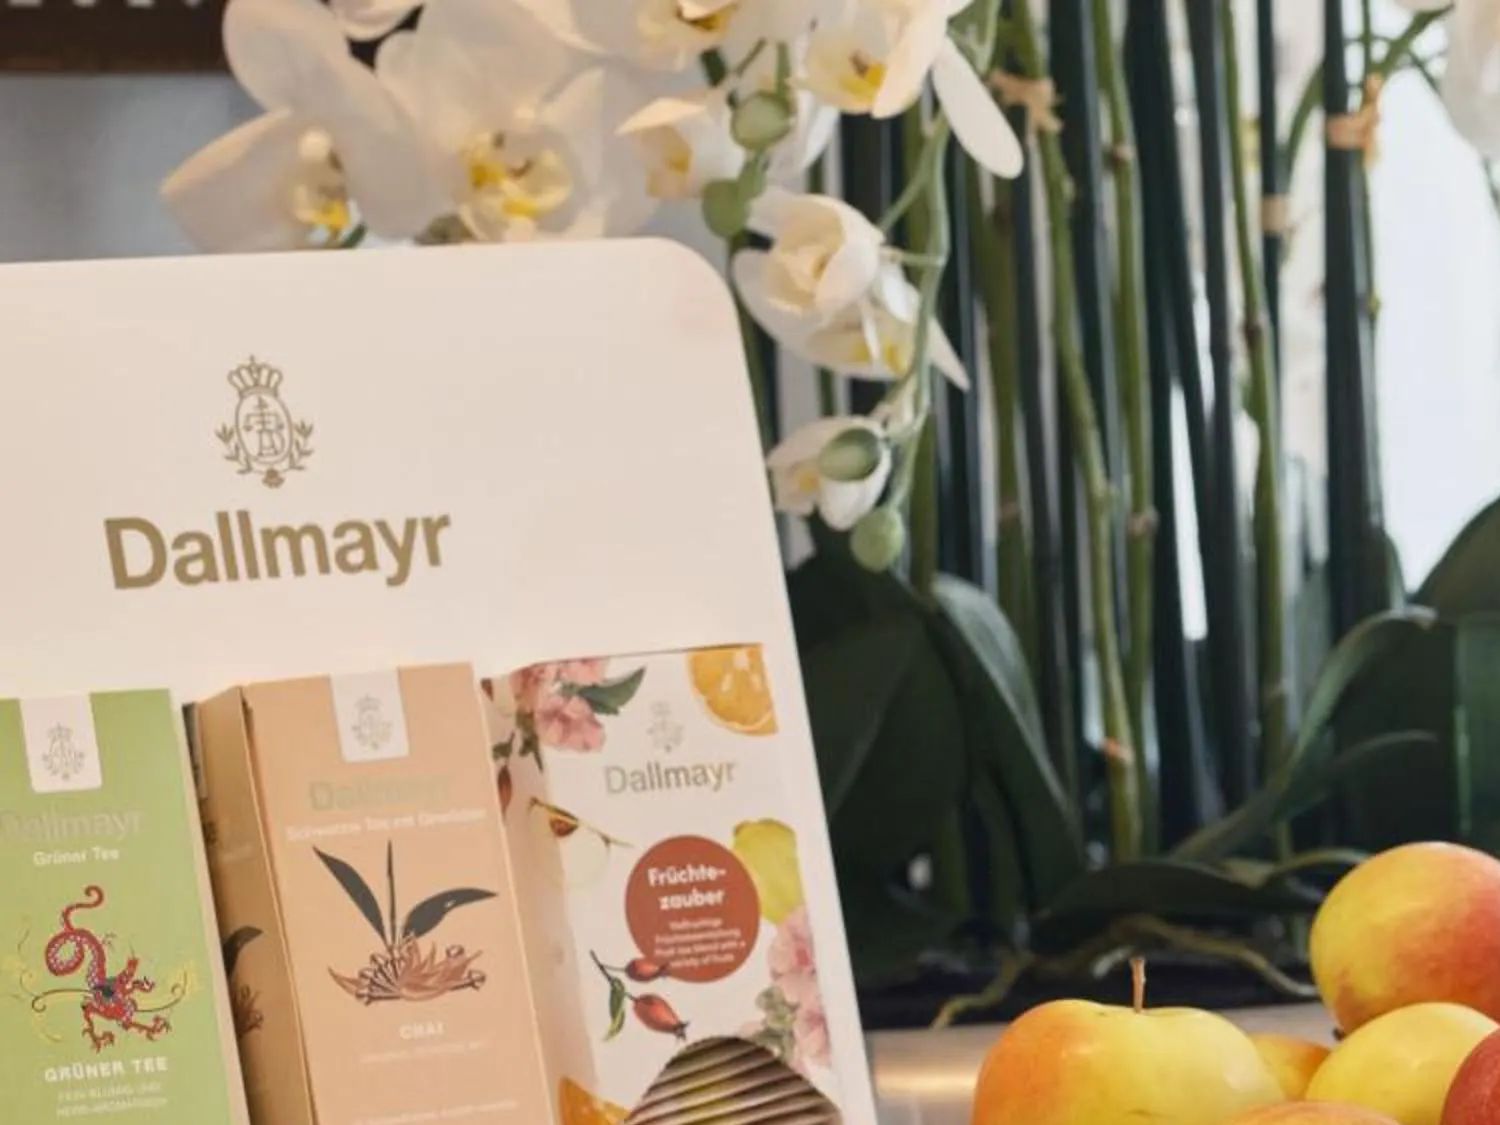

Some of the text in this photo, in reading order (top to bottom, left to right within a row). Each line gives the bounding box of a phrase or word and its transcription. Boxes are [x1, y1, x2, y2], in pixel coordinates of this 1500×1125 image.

[103, 509, 453, 590] Dallmayr
[604, 759, 738, 794] Dallmayr
[33, 846, 121, 867] Grüner Tee
[648, 863, 727, 887] Früchte-
[658, 886, 725, 910] zauber
[399, 1022, 445, 1041] CHAI
[44, 1056, 169, 1083] GRÜNER TEE
